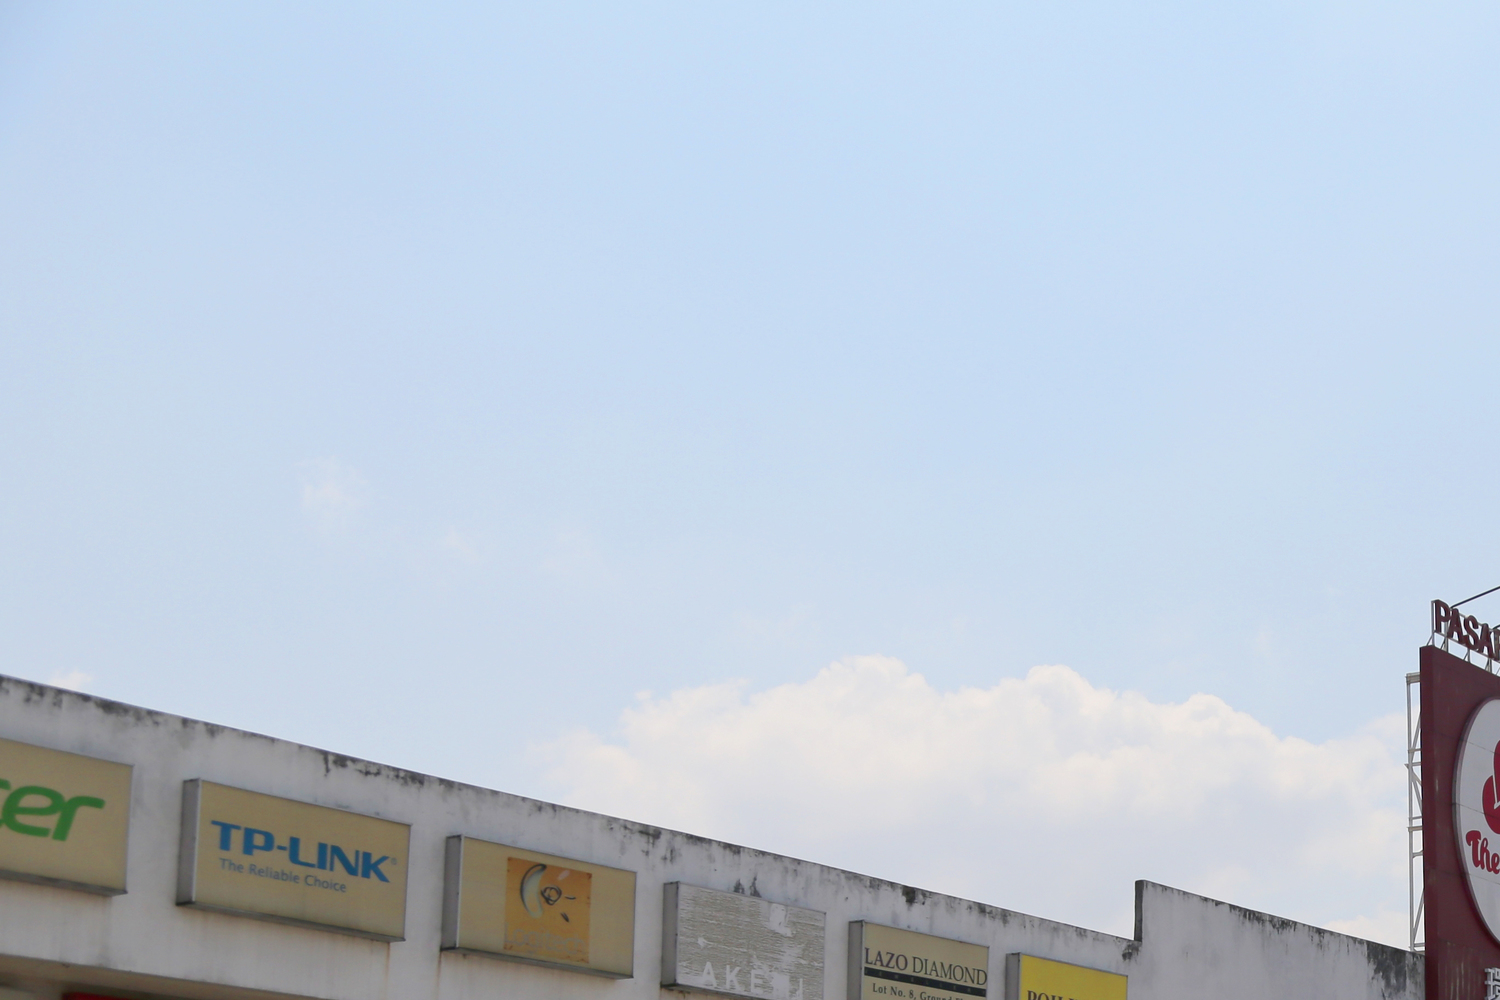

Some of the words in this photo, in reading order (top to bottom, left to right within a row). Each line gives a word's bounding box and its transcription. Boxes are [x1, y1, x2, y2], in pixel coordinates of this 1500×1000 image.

[0, 778, 106, 842] er
[211, 820, 390, 883] TP-LINK
[219, 857, 244, 874] The
[249, 863, 300, 884] Reliable
[304, 874, 347, 893] Choice
[864, 947, 908, 971] LAZO
[912, 956, 988, 986] DIAMOND
[872, 982, 887, 994] Lot
[890, 986, 906, 998] No.
